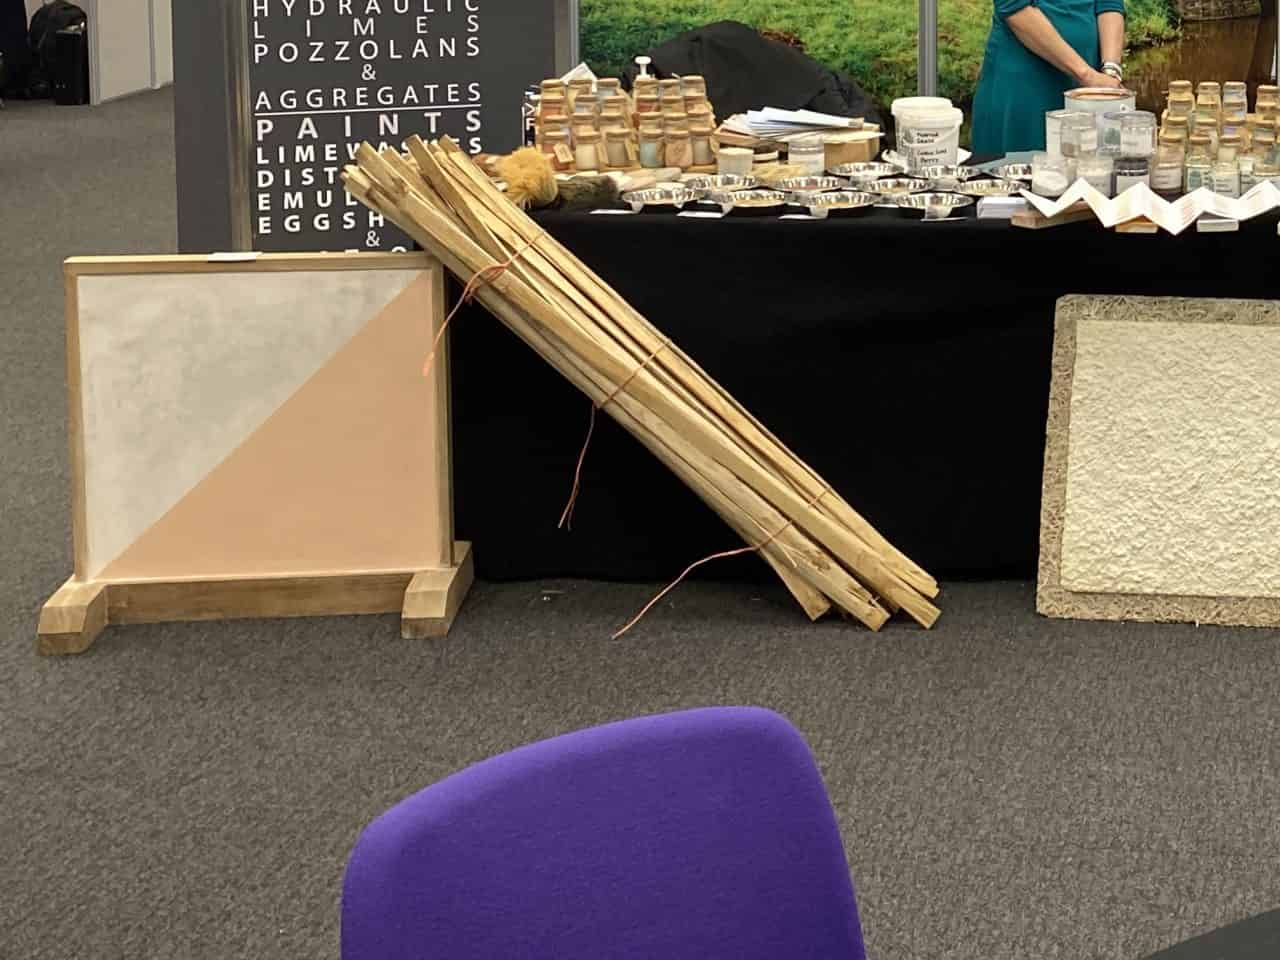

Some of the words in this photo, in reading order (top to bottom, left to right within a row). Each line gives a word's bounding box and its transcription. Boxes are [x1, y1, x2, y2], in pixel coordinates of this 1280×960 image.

[254, 15, 479, 39] LIMES
[254, 36, 480, 64] POZZOLANS
[361, 63, 376, 81] &
[255, 82, 481, 111] AGGREGATES
[256, 110, 482, 141] PAINTS
[258, 211, 385, 234] EGGSH
[366, 230, 381, 248] &
